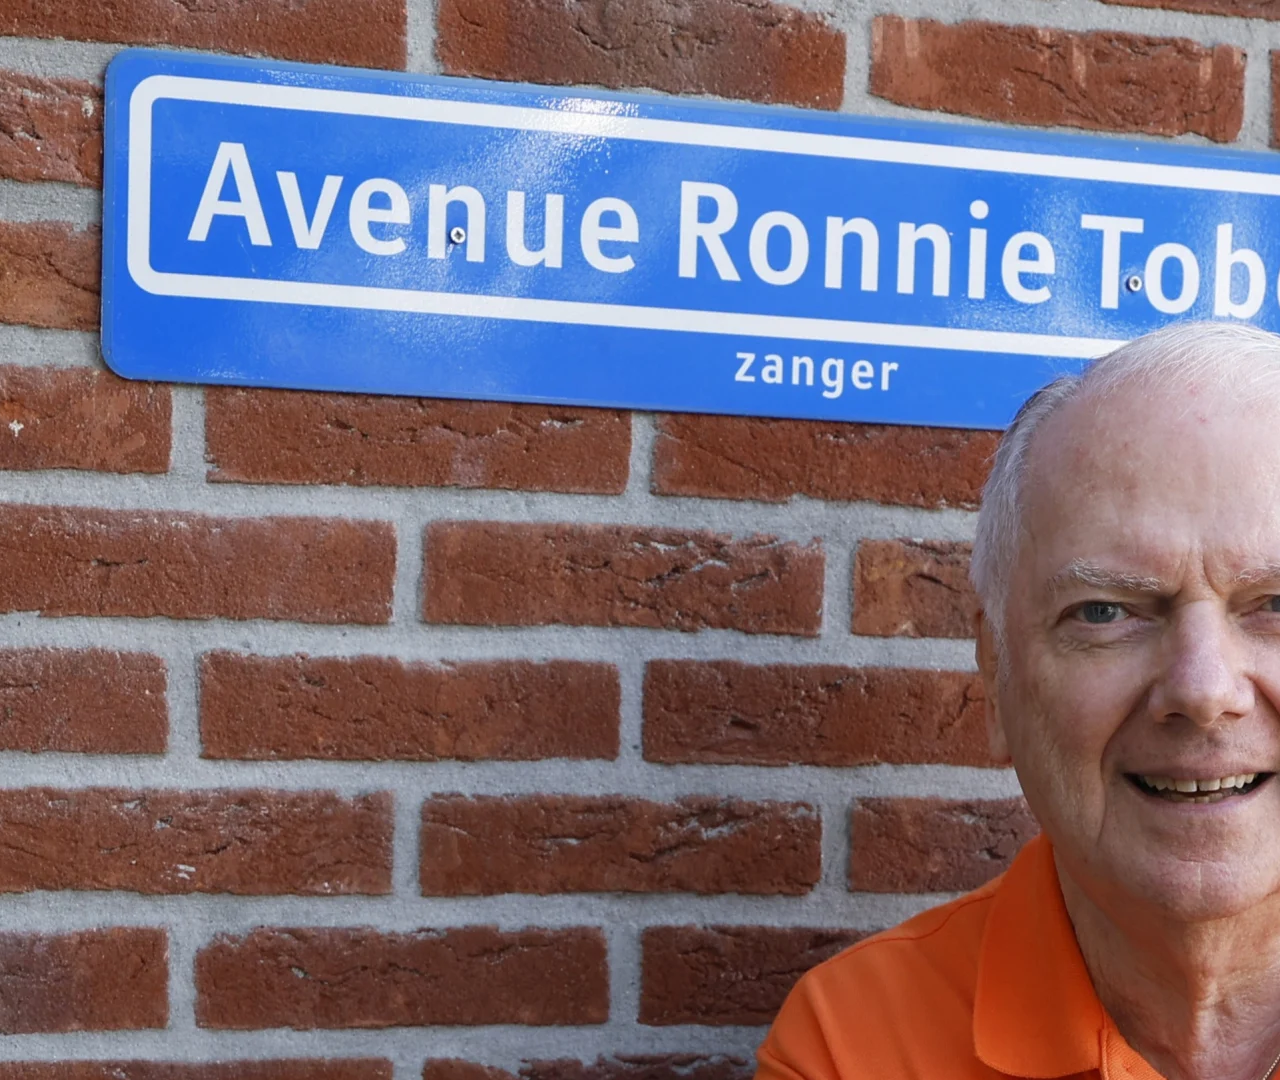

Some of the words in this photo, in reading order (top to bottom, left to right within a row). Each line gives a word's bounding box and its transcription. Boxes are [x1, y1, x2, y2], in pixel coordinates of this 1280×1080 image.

[187, 141, 640, 274] Avenue
[678, 181, 1056, 305] Ronnie
[735, 350, 900, 399] zanger
